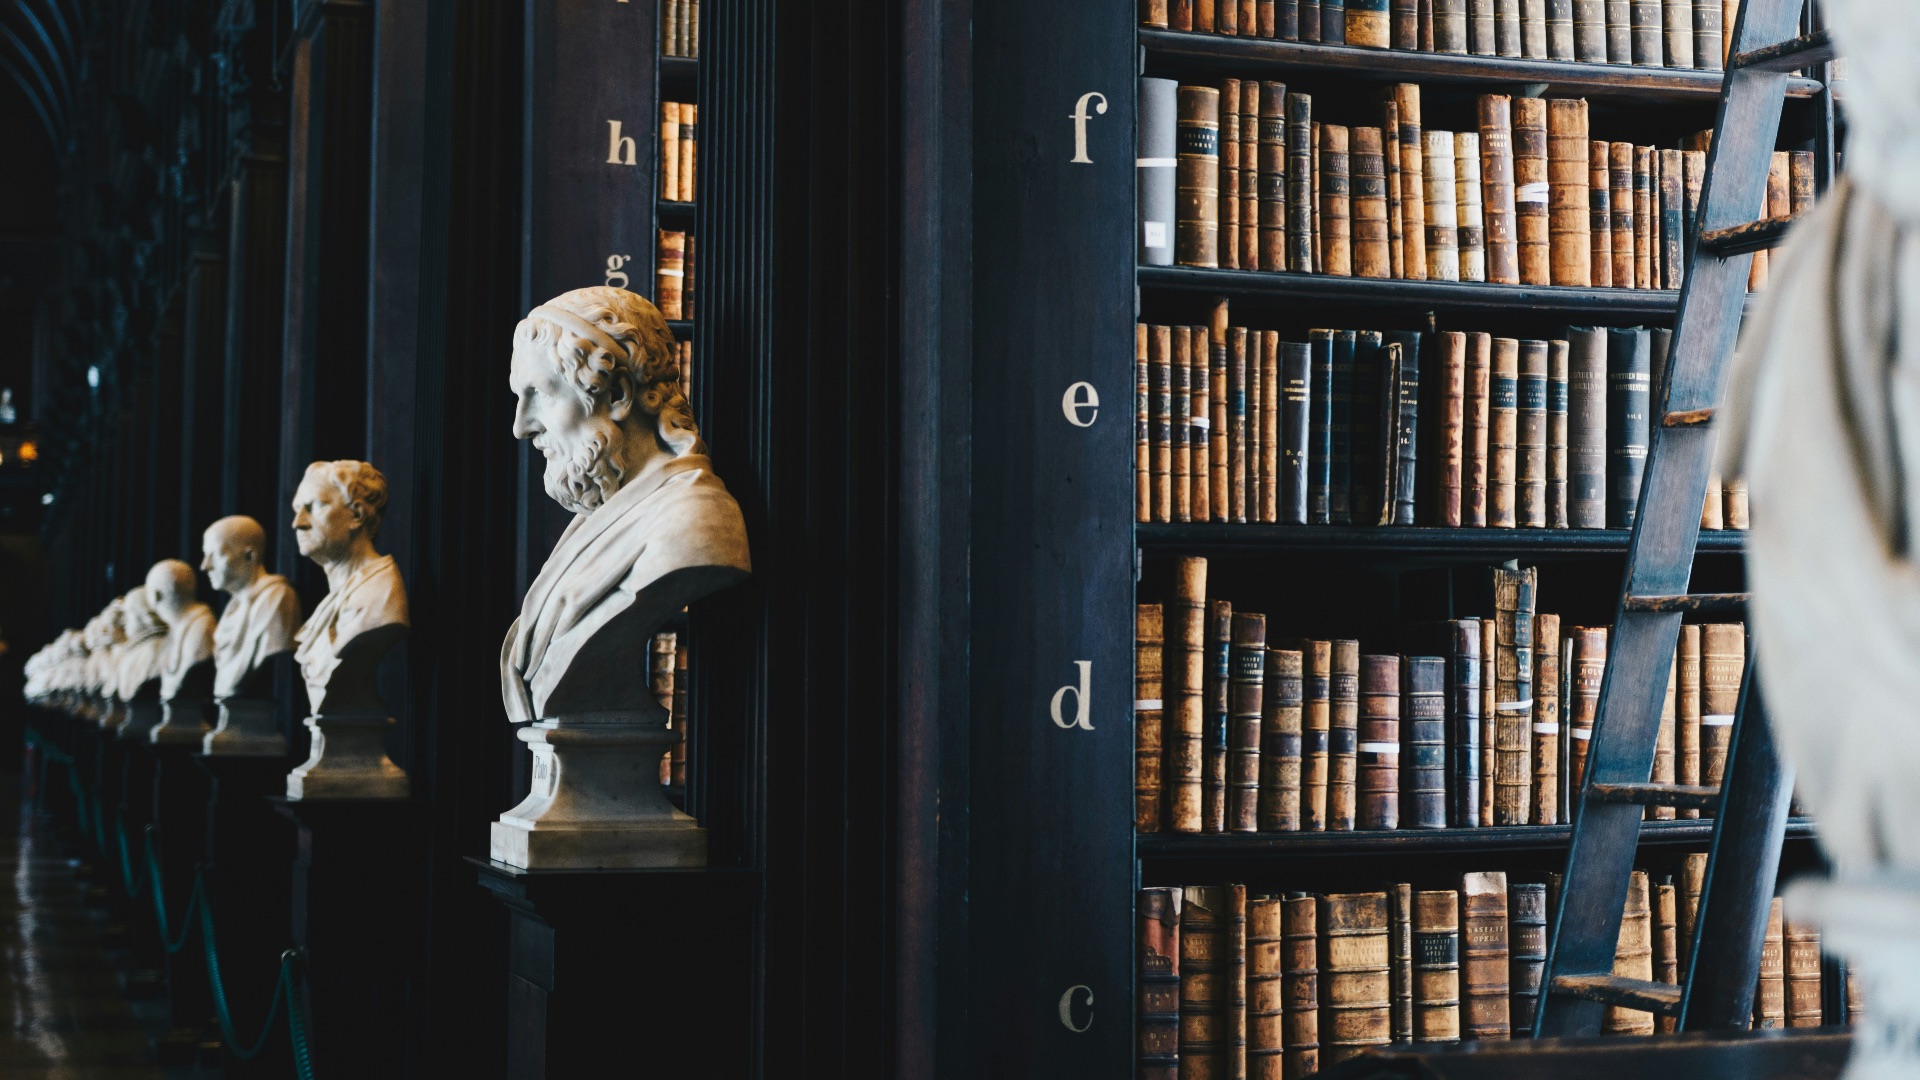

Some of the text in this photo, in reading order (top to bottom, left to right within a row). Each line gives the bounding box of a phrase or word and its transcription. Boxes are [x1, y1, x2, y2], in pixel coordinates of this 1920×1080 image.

[606, 119, 637, 166] h
[1068, 92, 1108, 164] f
[605, 254, 632, 288] g
[1061, 381, 1100, 428] e
[1050, 660, 1096, 731] d
[1473, 935, 1501, 943] OPERA
[1058, 984, 1094, 1033] c
